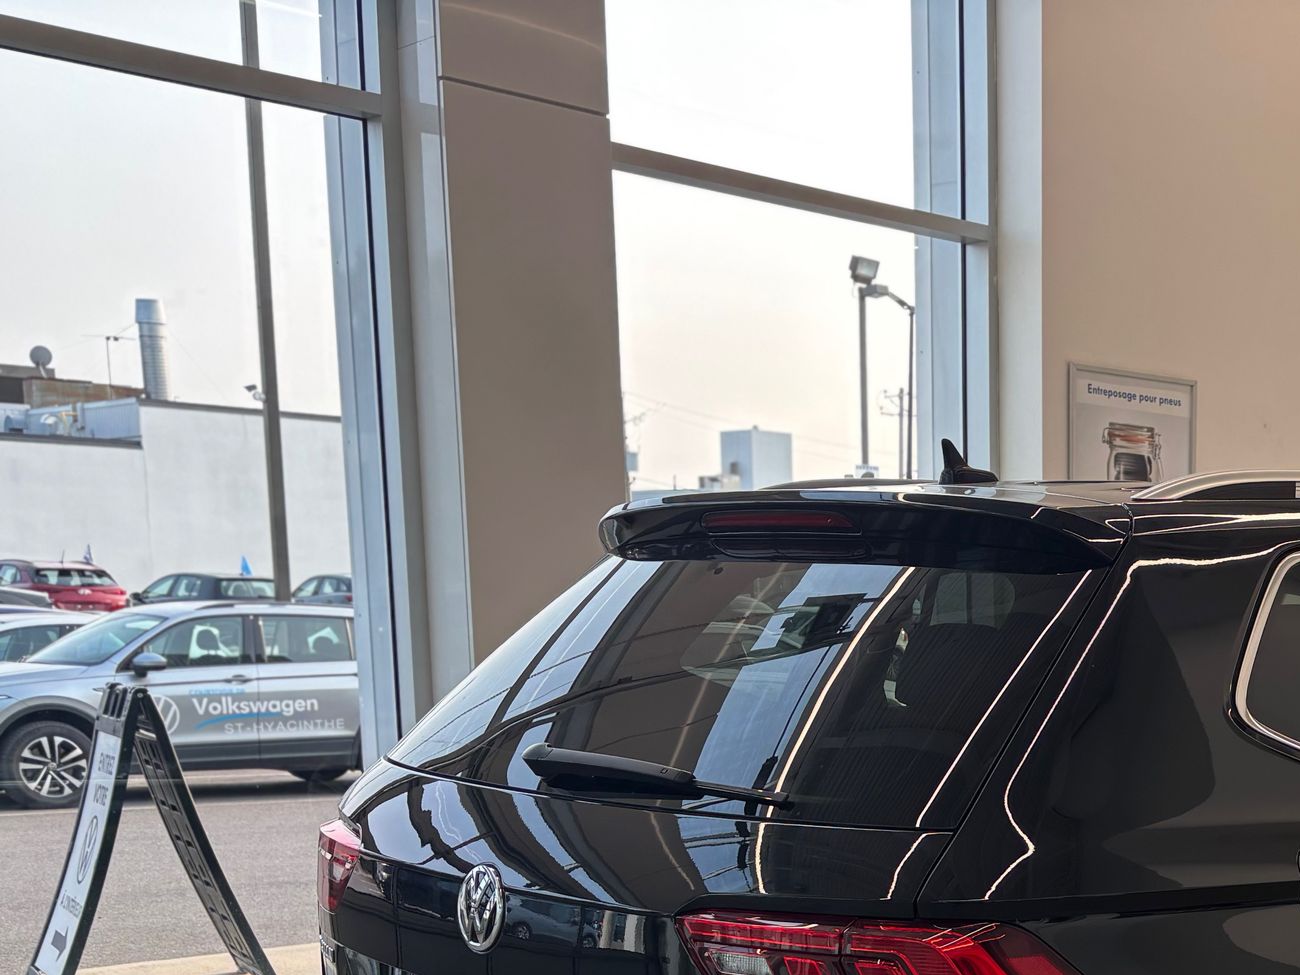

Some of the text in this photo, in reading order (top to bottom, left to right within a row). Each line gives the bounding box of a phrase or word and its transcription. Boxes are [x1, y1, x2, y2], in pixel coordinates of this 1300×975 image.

[1087, 383, 1182, 407] Entreposage pour pneus
[192, 696, 319, 716] Volkswagen
[224, 718, 345, 735] ST-HYACINTHE
